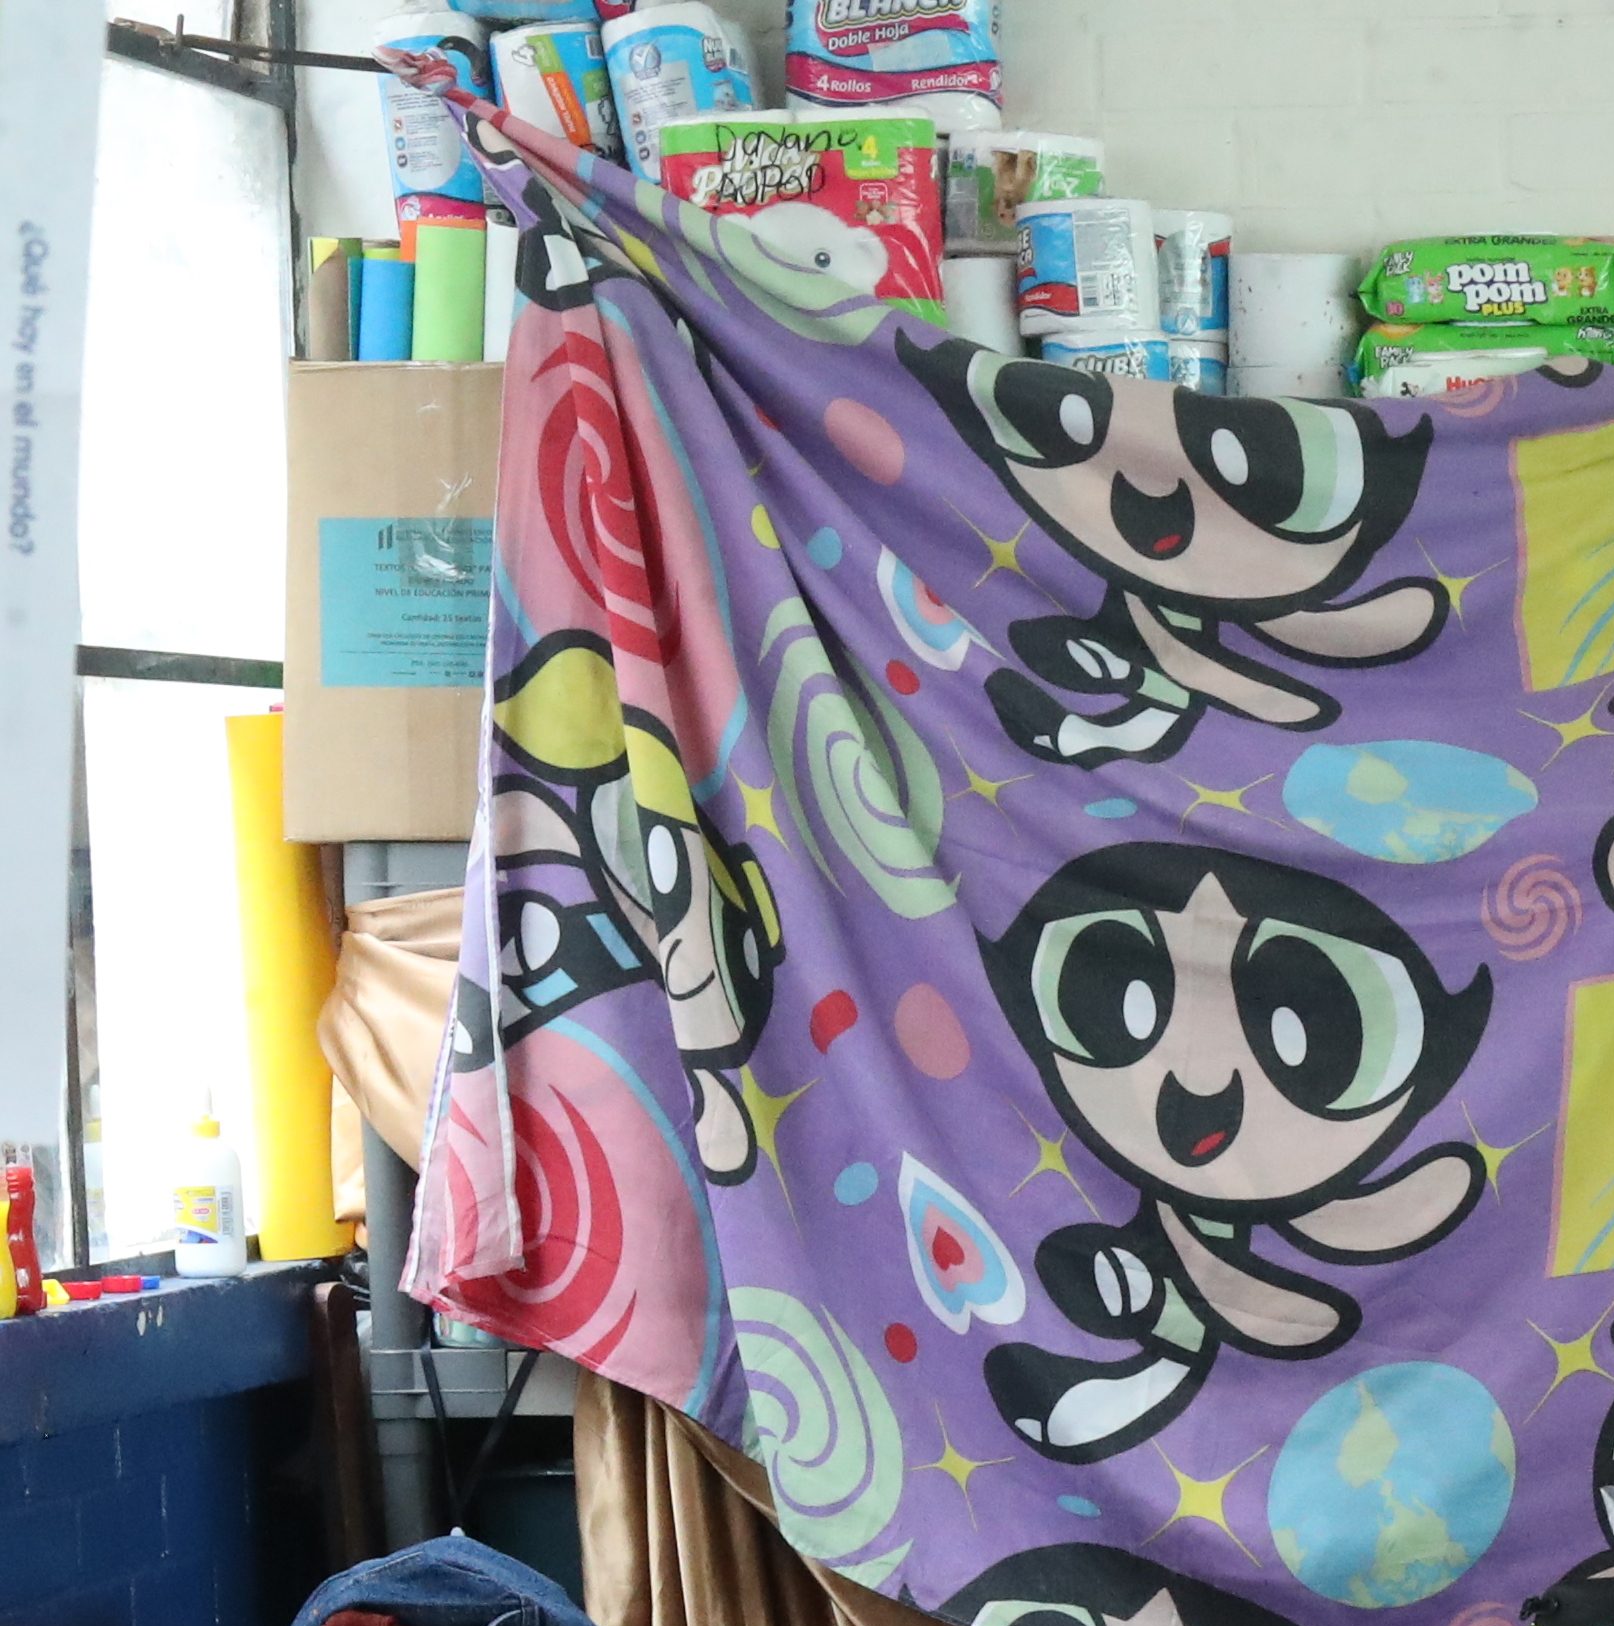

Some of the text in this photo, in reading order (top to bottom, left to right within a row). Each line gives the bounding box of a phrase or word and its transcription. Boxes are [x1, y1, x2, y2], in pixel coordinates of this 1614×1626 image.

[828, 23, 910, 51] Doble Hoja
[830, 82, 872, 93] Rollos
[861, 134, 878, 159] 4
[1446, 262, 1530, 292] pom
[1463, 281, 1548, 313] pom
[1482, 302, 1525, 316] PLUS
[1579, 306, 1609, 315] EXTRA
[12, 303, 46, 354] hoy
[15, 361, 36, 393] en
[13, 401, 40, 429] el
[8, 434, 37, 556] mundo?
